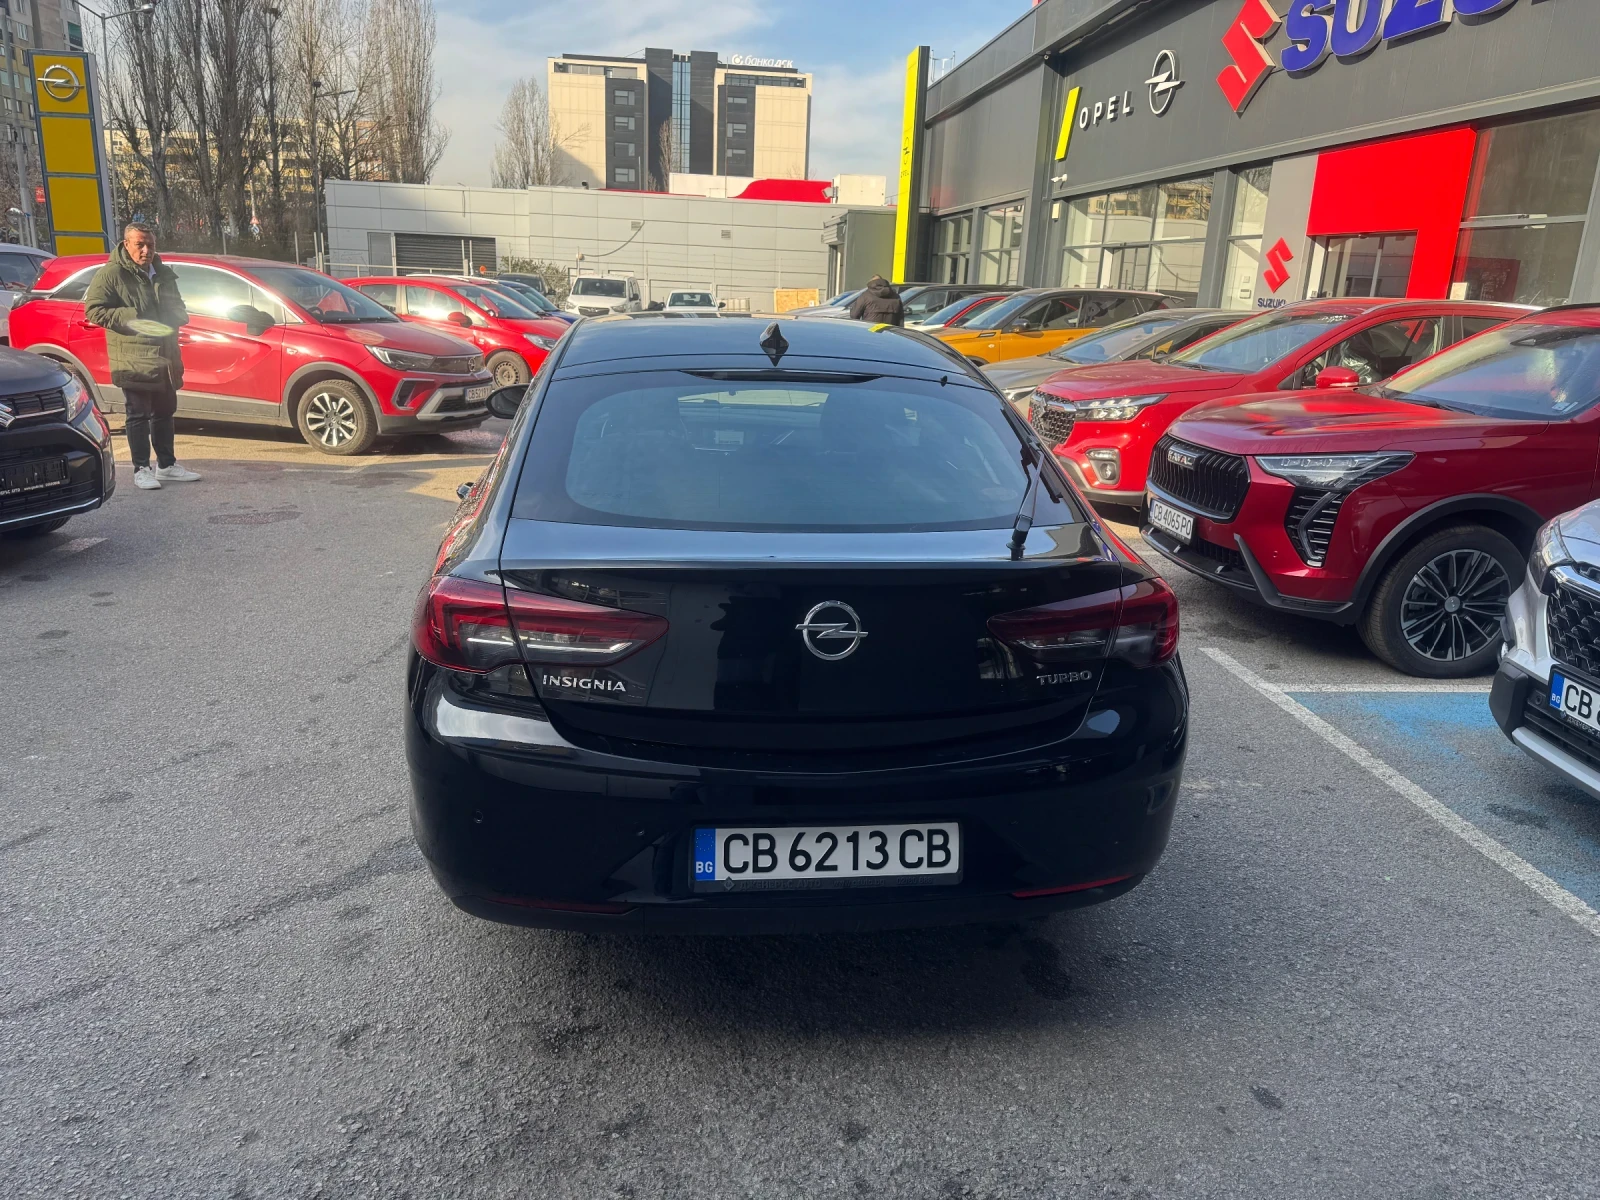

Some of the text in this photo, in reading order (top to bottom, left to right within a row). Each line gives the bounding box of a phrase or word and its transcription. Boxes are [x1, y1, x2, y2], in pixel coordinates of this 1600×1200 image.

[1079, 90, 1132, 129] OPEL
[1257, 297, 1287, 309] SUZUKI
[1153, 503, 1163, 521] CB
[1163, 508, 1181, 531] 4065
[1180, 516, 1192, 536] PO
[542, 674, 627, 692] INSIGNIA
[1036, 669, 1093, 686] TURBO
[1552, 693, 1560, 703] BG
[1564, 684, 1593, 719] CB
[723, 828, 952, 874] CB 6213 CB
[695, 861, 714, 873] BG
